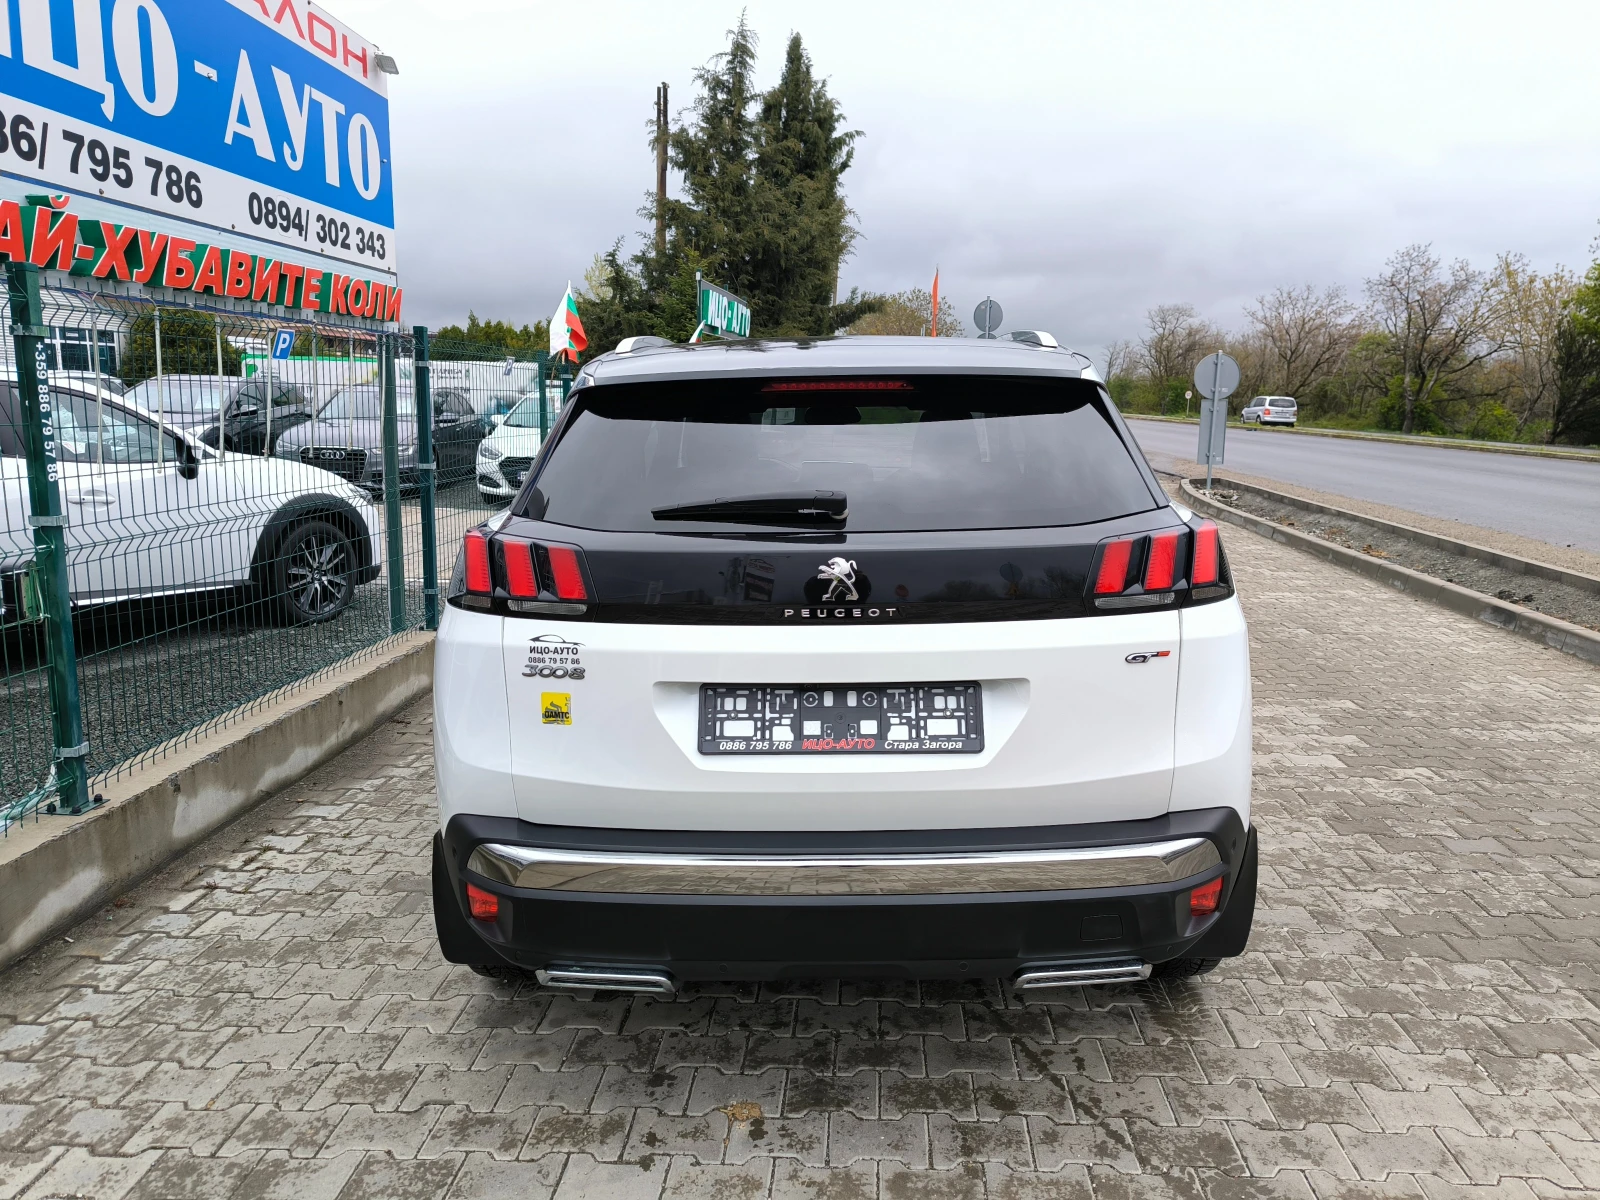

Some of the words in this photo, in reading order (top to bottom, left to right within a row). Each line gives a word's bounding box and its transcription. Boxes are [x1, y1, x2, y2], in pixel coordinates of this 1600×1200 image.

[0, 0, 381, 200] ЦО-АУТО
[62, 129, 134, 189] 795
[145, 156, 203, 209] 786
[248, 191, 310, 242] 0894/
[316, 213, 351, 251] 302
[355, 226, 386, 260] 343
[329, 273, 403, 322] КОЛИ
[707, 289, 751, 338] ИЦО-АУТО
[275, 333, 290, 357] P
[35, 341, 48, 380] +359
[37, 384, 51, 413] 886
[41, 416, 54, 436] 79
[44, 440, 56, 460] 57
[46, 463, 59, 482] 86
[783, 608, 897, 618] PEUGEOT
[528, 656, 547, 664] 0886
[548, 657, 558, 665] 79
[559, 657, 569, 665] 57
[570, 657, 581, 665] 86
[529, 645, 579, 656] ИЦО-АУТО
[1125, 651, 1171, 663] GT
[521, 664, 586, 680] 3008
[719, 741, 746, 750] 0886
[749, 741, 770, 750] 795
[772, 741, 793, 750] 786
[801, 738, 876, 751] ИЦО-АУТО
[884, 740, 919, 750] Стара
[922, 740, 963, 750] Загора
